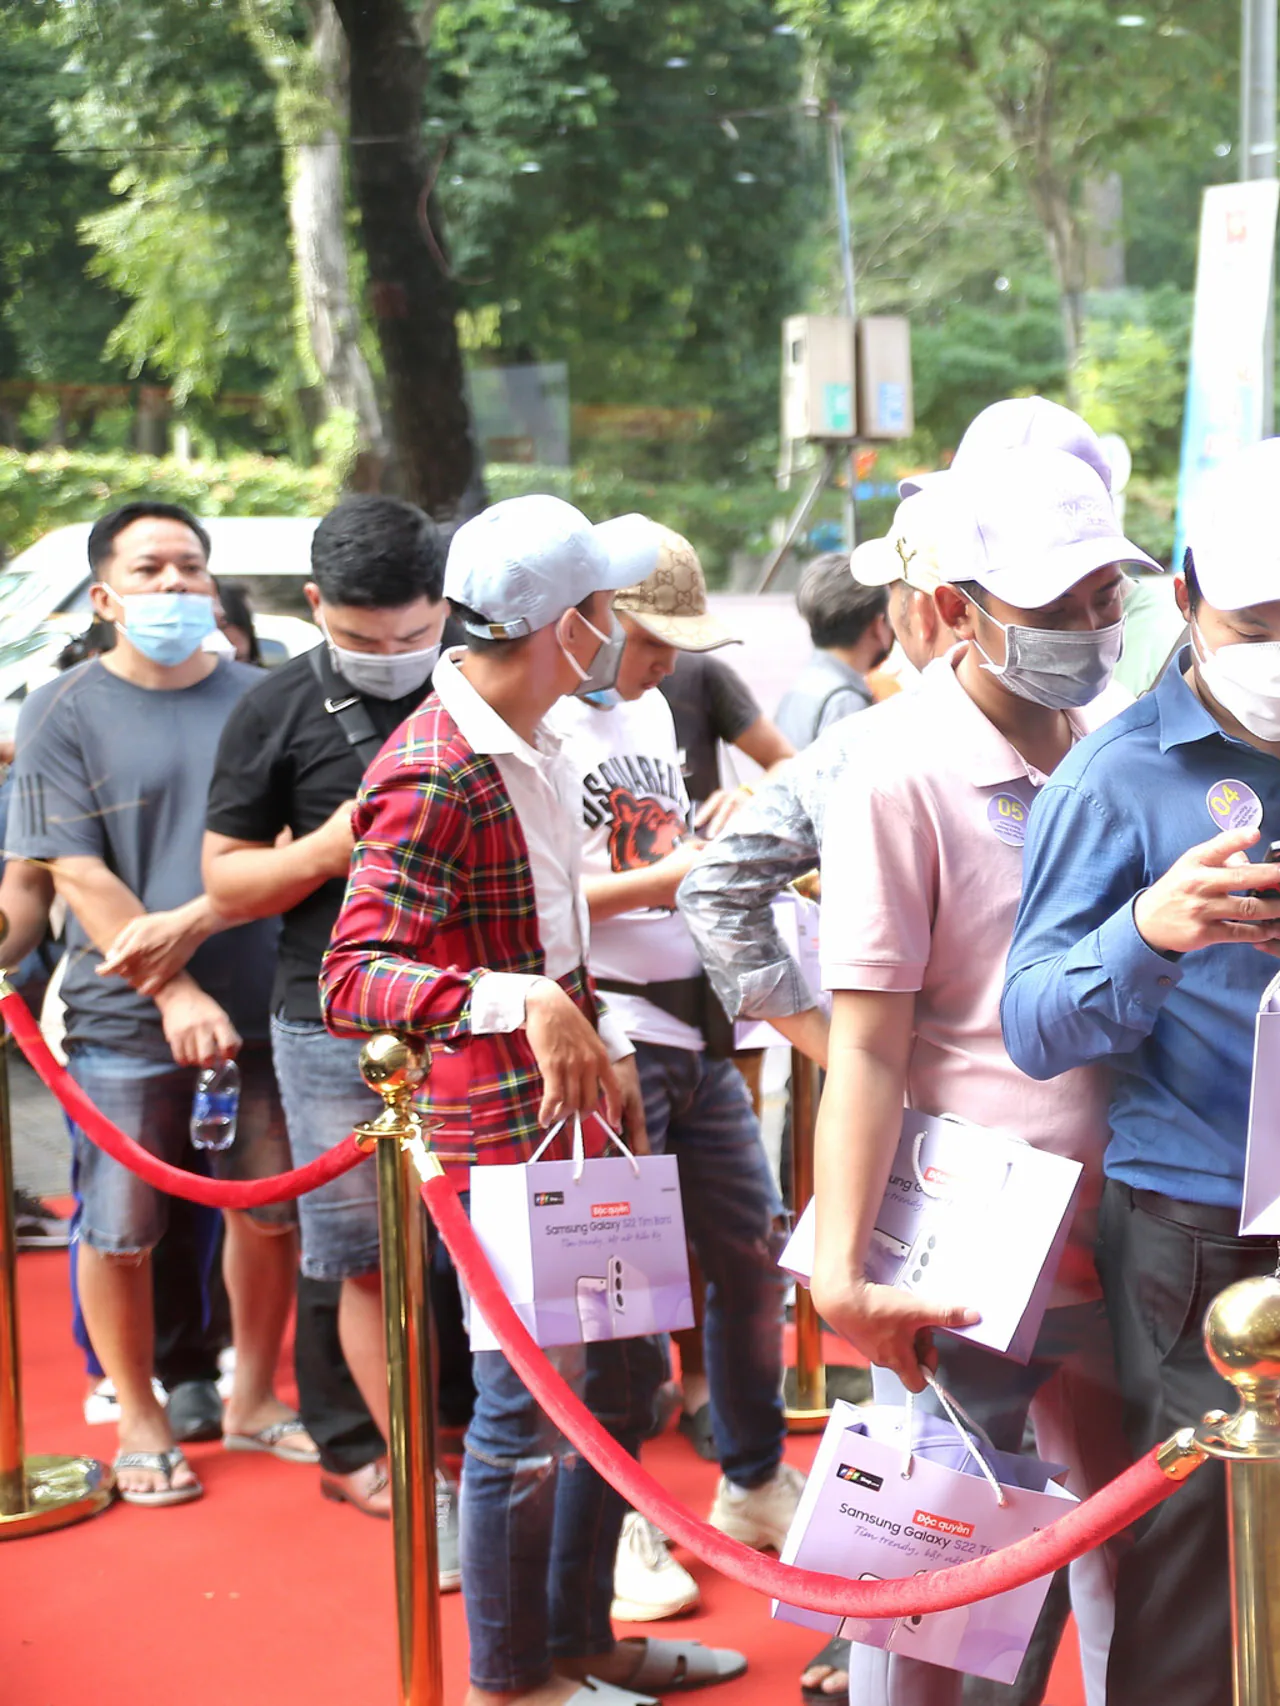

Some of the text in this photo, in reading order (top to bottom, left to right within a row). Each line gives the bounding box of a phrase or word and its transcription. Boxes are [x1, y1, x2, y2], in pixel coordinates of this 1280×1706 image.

[998, 798, 1024, 821] 05
[1211, 784, 1240, 815] 04
[545, 1224, 588, 1236] Samsung
[589, 1220, 621, 1233] Galaxy
[839, 1502, 901, 1536] Samsung
[903, 1526, 951, 1549] Galaxy
[953, 1539, 977, 1554] S22
[917, 1513, 970, 1536] Độc quyền
